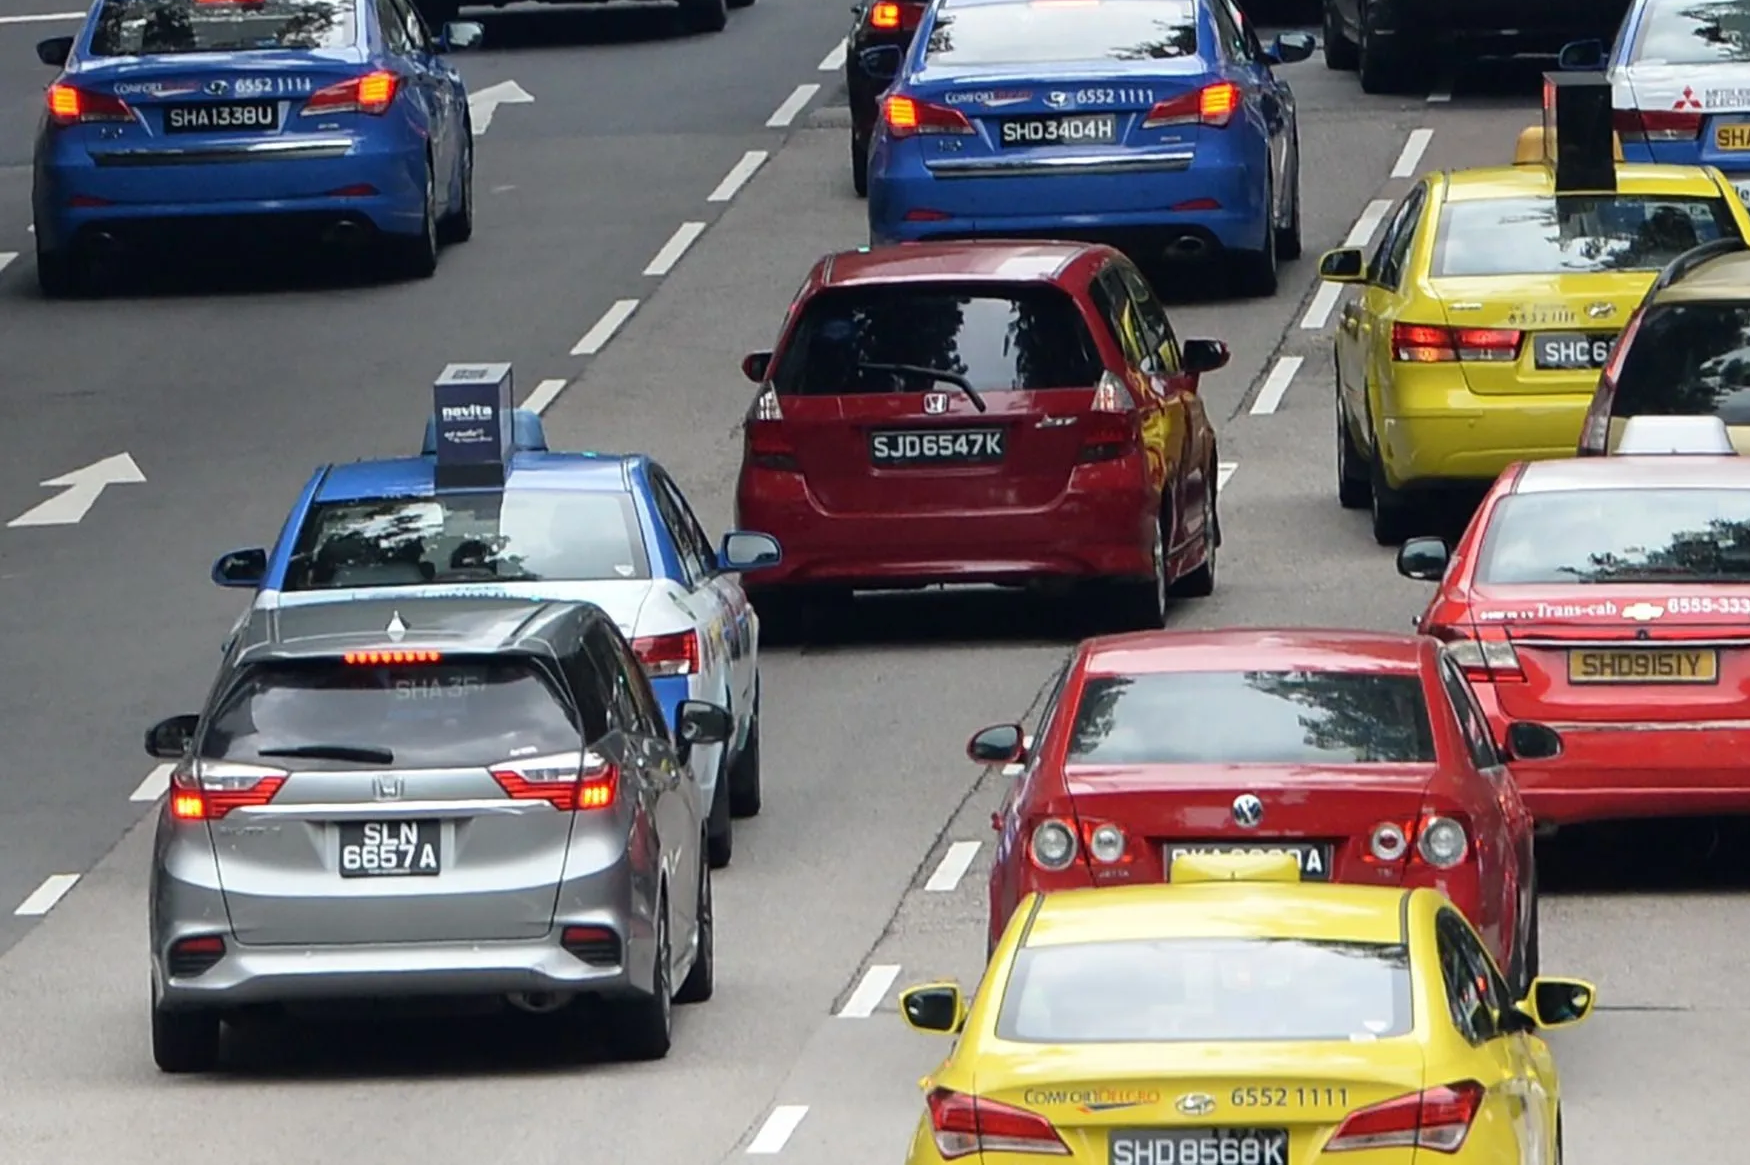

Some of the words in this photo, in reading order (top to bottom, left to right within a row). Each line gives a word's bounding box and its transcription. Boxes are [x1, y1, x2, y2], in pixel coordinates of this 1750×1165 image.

[234, 78, 273, 92] 6552
[277, 78, 311, 92] 1111
[1076, 90, 1114, 104] 6552
[1119, 89, 1154, 104] 1111
[170, 106, 272, 127] SHA1338U
[1003, 119, 1112, 141] SHD3404H
[873, 434, 1002, 458] SJD6547K
[1536, 601, 1617, 618] Trans-cab
[1581, 653, 1701, 676] SHD9151Y
[363, 823, 419, 845] SLN
[342, 845, 438, 869] 6657A
[1231, 1087, 1288, 1107] 6552
[1297, 1087, 1348, 1107] 1111
[1113, 1139, 1283, 1165] SHD8568K
